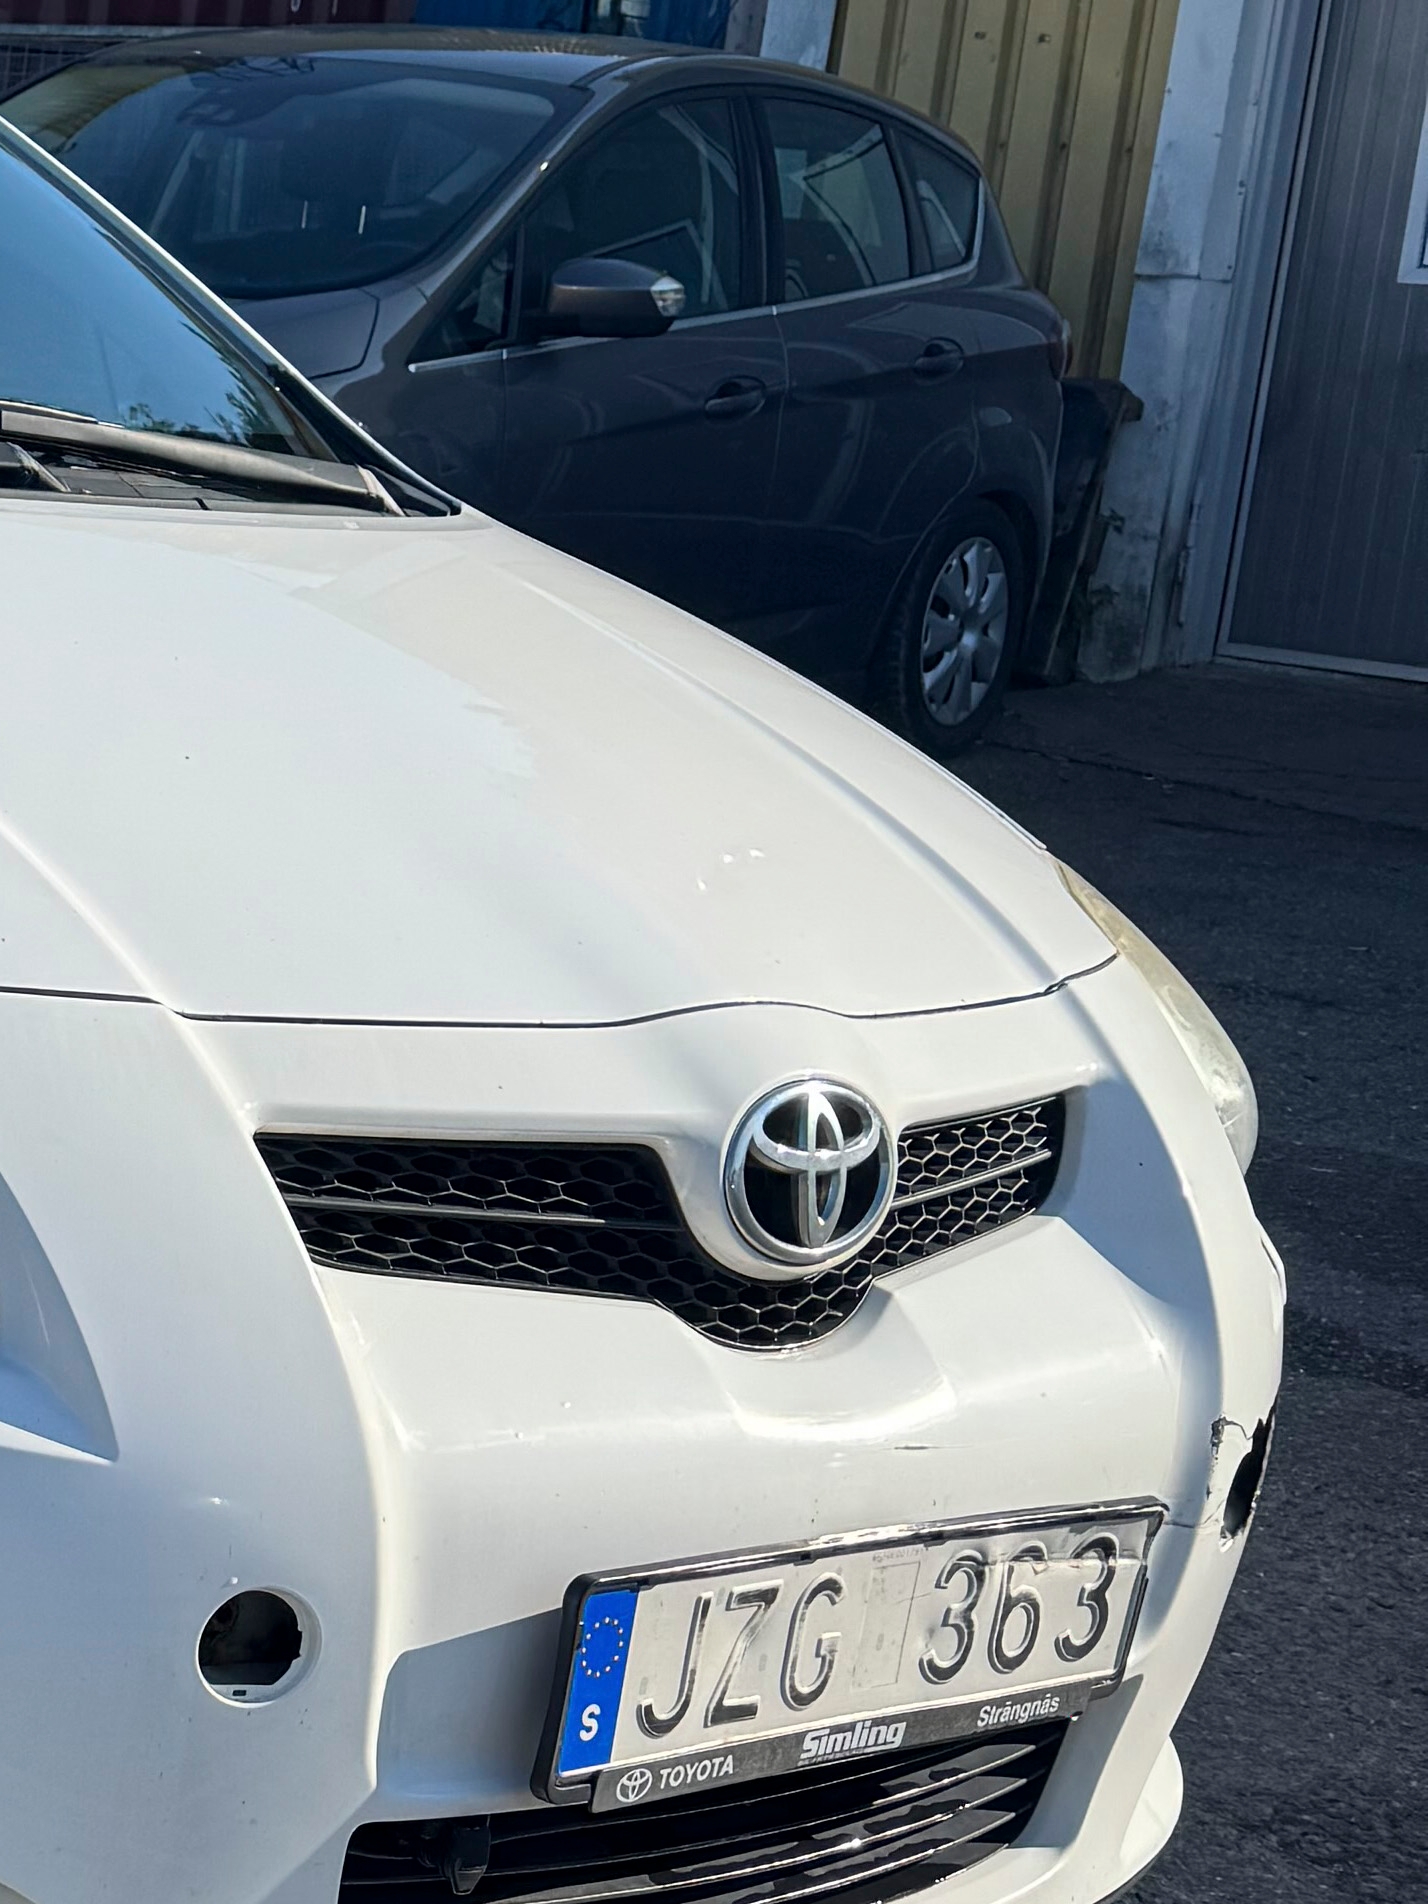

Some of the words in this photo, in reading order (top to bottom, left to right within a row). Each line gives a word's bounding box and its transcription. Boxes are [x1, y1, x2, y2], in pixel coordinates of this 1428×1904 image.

[635, 1571, 848, 1740] JZG
[918, 1532, 1120, 1685] 363
[579, 1703, 601, 1742] S
[659, 1754, 735, 1790] TOYOTA
[799, 1719, 907, 1760] Simling
[976, 1693, 1061, 1727] Strängnäs
